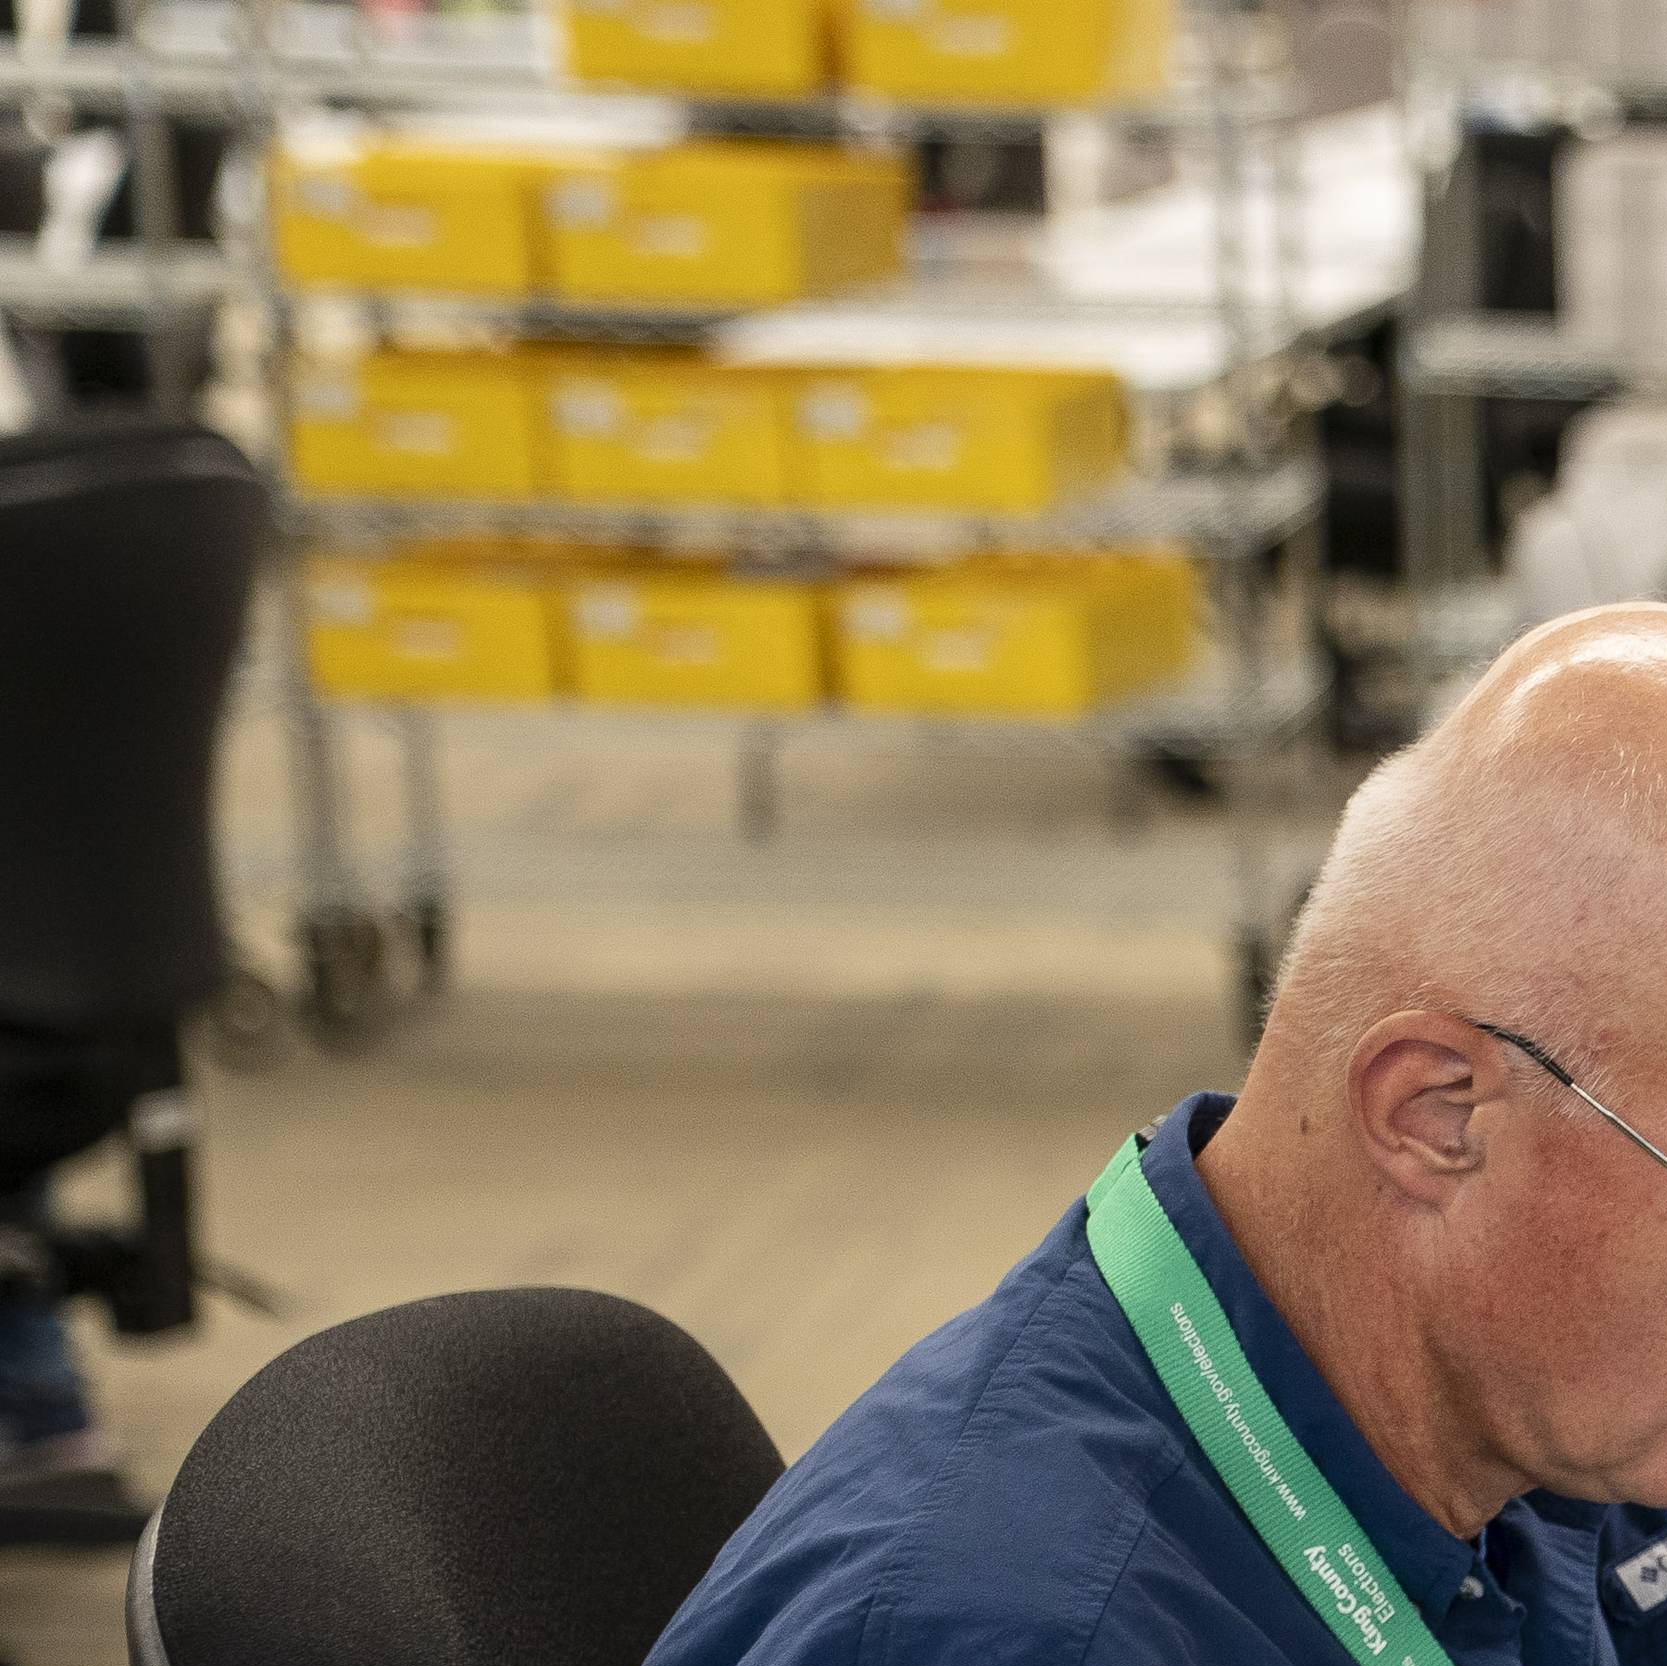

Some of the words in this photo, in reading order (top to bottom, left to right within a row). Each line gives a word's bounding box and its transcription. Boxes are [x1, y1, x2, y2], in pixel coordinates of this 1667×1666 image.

[1158, 1299, 1313, 1525] www.kingcounty.gov/elections
[1298, 1538, 1362, 1618] County
[1333, 1538, 1399, 1626] Elections
[1347, 1602, 1394, 1657] King
